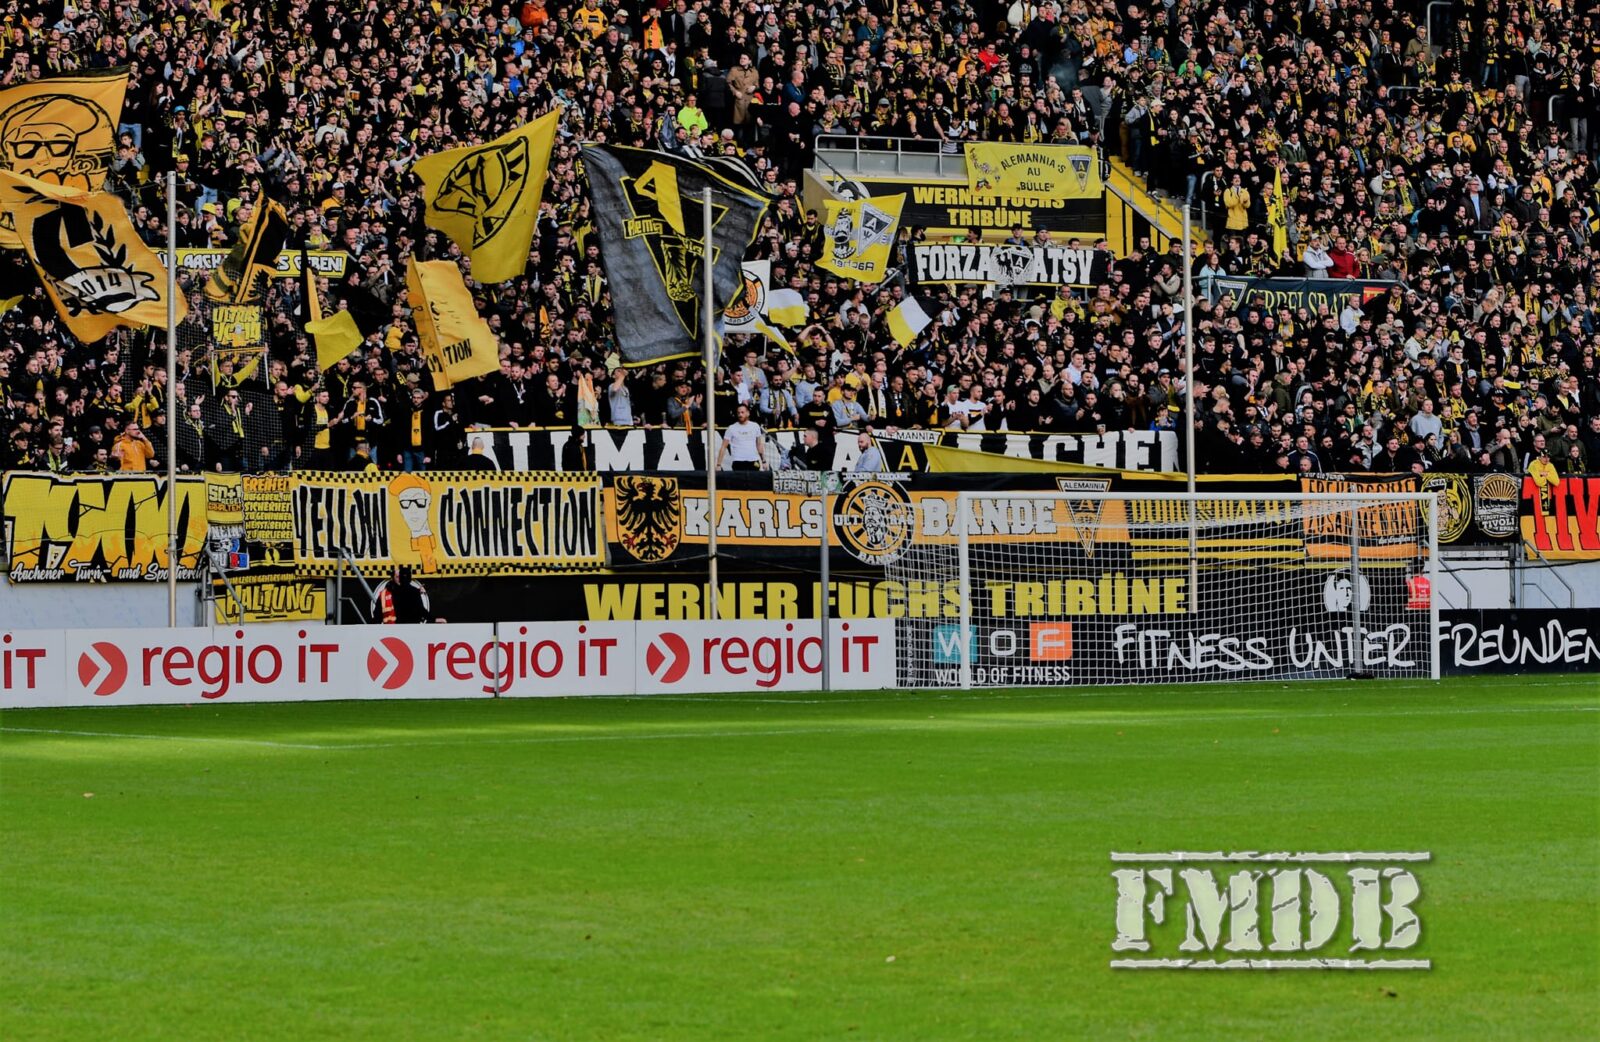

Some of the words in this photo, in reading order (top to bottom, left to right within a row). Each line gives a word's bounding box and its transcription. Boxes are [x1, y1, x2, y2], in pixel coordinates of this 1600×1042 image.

[1027, 167, 1041, 176] AU
[946, 208, 1032, 228] TRIBÜNE
[915, 246, 995, 281] FORZA
[1030, 247, 1094, 285] ATSV
[898, 445, 918, 471] A
[242, 476, 290, 492] FREIHEI
[1063, 482, 1106, 491] ALEMANNIA
[293, 484, 388, 560] YELLOW
[440, 486, 598, 558] CONNECTION
[683, 497, 825, 538] KARLS
[921, 496, 1057, 537] BANDE
[1481, 517, 1515, 530] TIVOLI
[10, 562, 64, 583] Aachener
[68, 558, 112, 582] Turn-
[119, 563, 141, 581] und
[226, 582, 314, 617] HALTUNG
[584, 582, 798, 621] WERNER
[813, 581, 972, 619] FUCHS
[985, 573, 1186, 617] TRIBÜNE
[142, 630, 283, 699] regio
[427, 627, 564, 694] regio
[703, 623, 825, 688] regio
[1113, 624, 1274, 671] FITNESS
[1289, 624, 1416, 668] UNTER
[935, 668, 986, 684] WOLD
[991, 667, 1009, 683] OF
[1013, 666, 1071, 682] FITNESS
